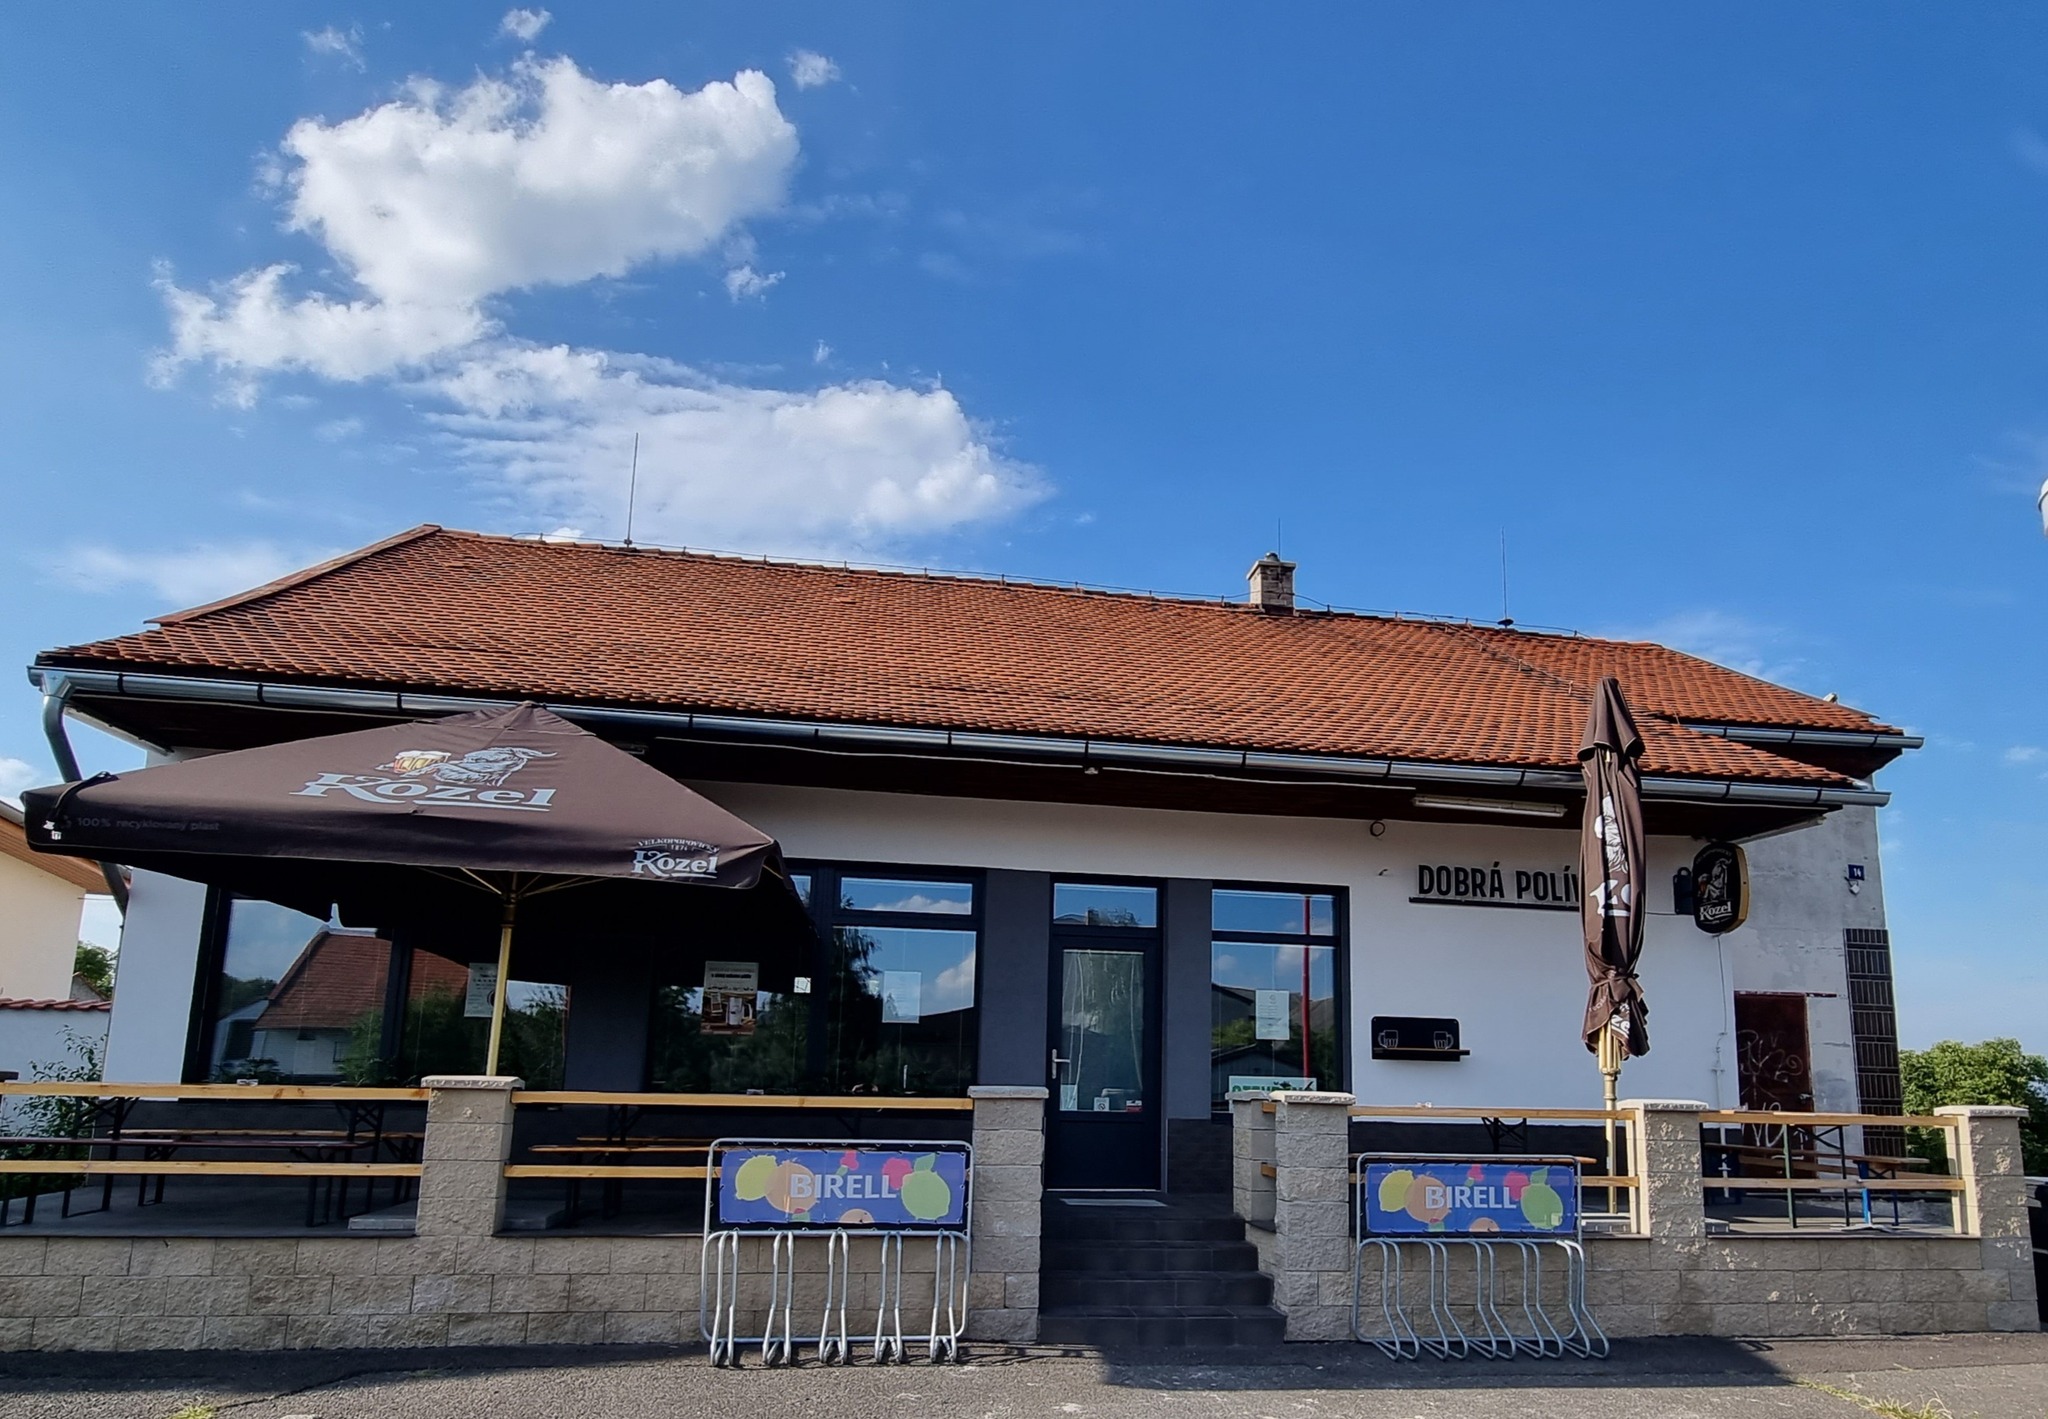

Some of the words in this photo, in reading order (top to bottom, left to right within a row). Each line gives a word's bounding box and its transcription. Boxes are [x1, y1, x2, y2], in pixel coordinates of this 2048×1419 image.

[289, 772, 557, 807] Kozel
[77, 817, 111, 828] 100%
[191, 821, 220, 831] plast
[631, 850, 718, 877] Kozel
[1418, 861, 1505, 898] DOBRÁ
[1699, 901, 1732, 920] Kozel
[789, 1174, 897, 1199] BIRELL
[1425, 1186, 1517, 1209] BIRELL
